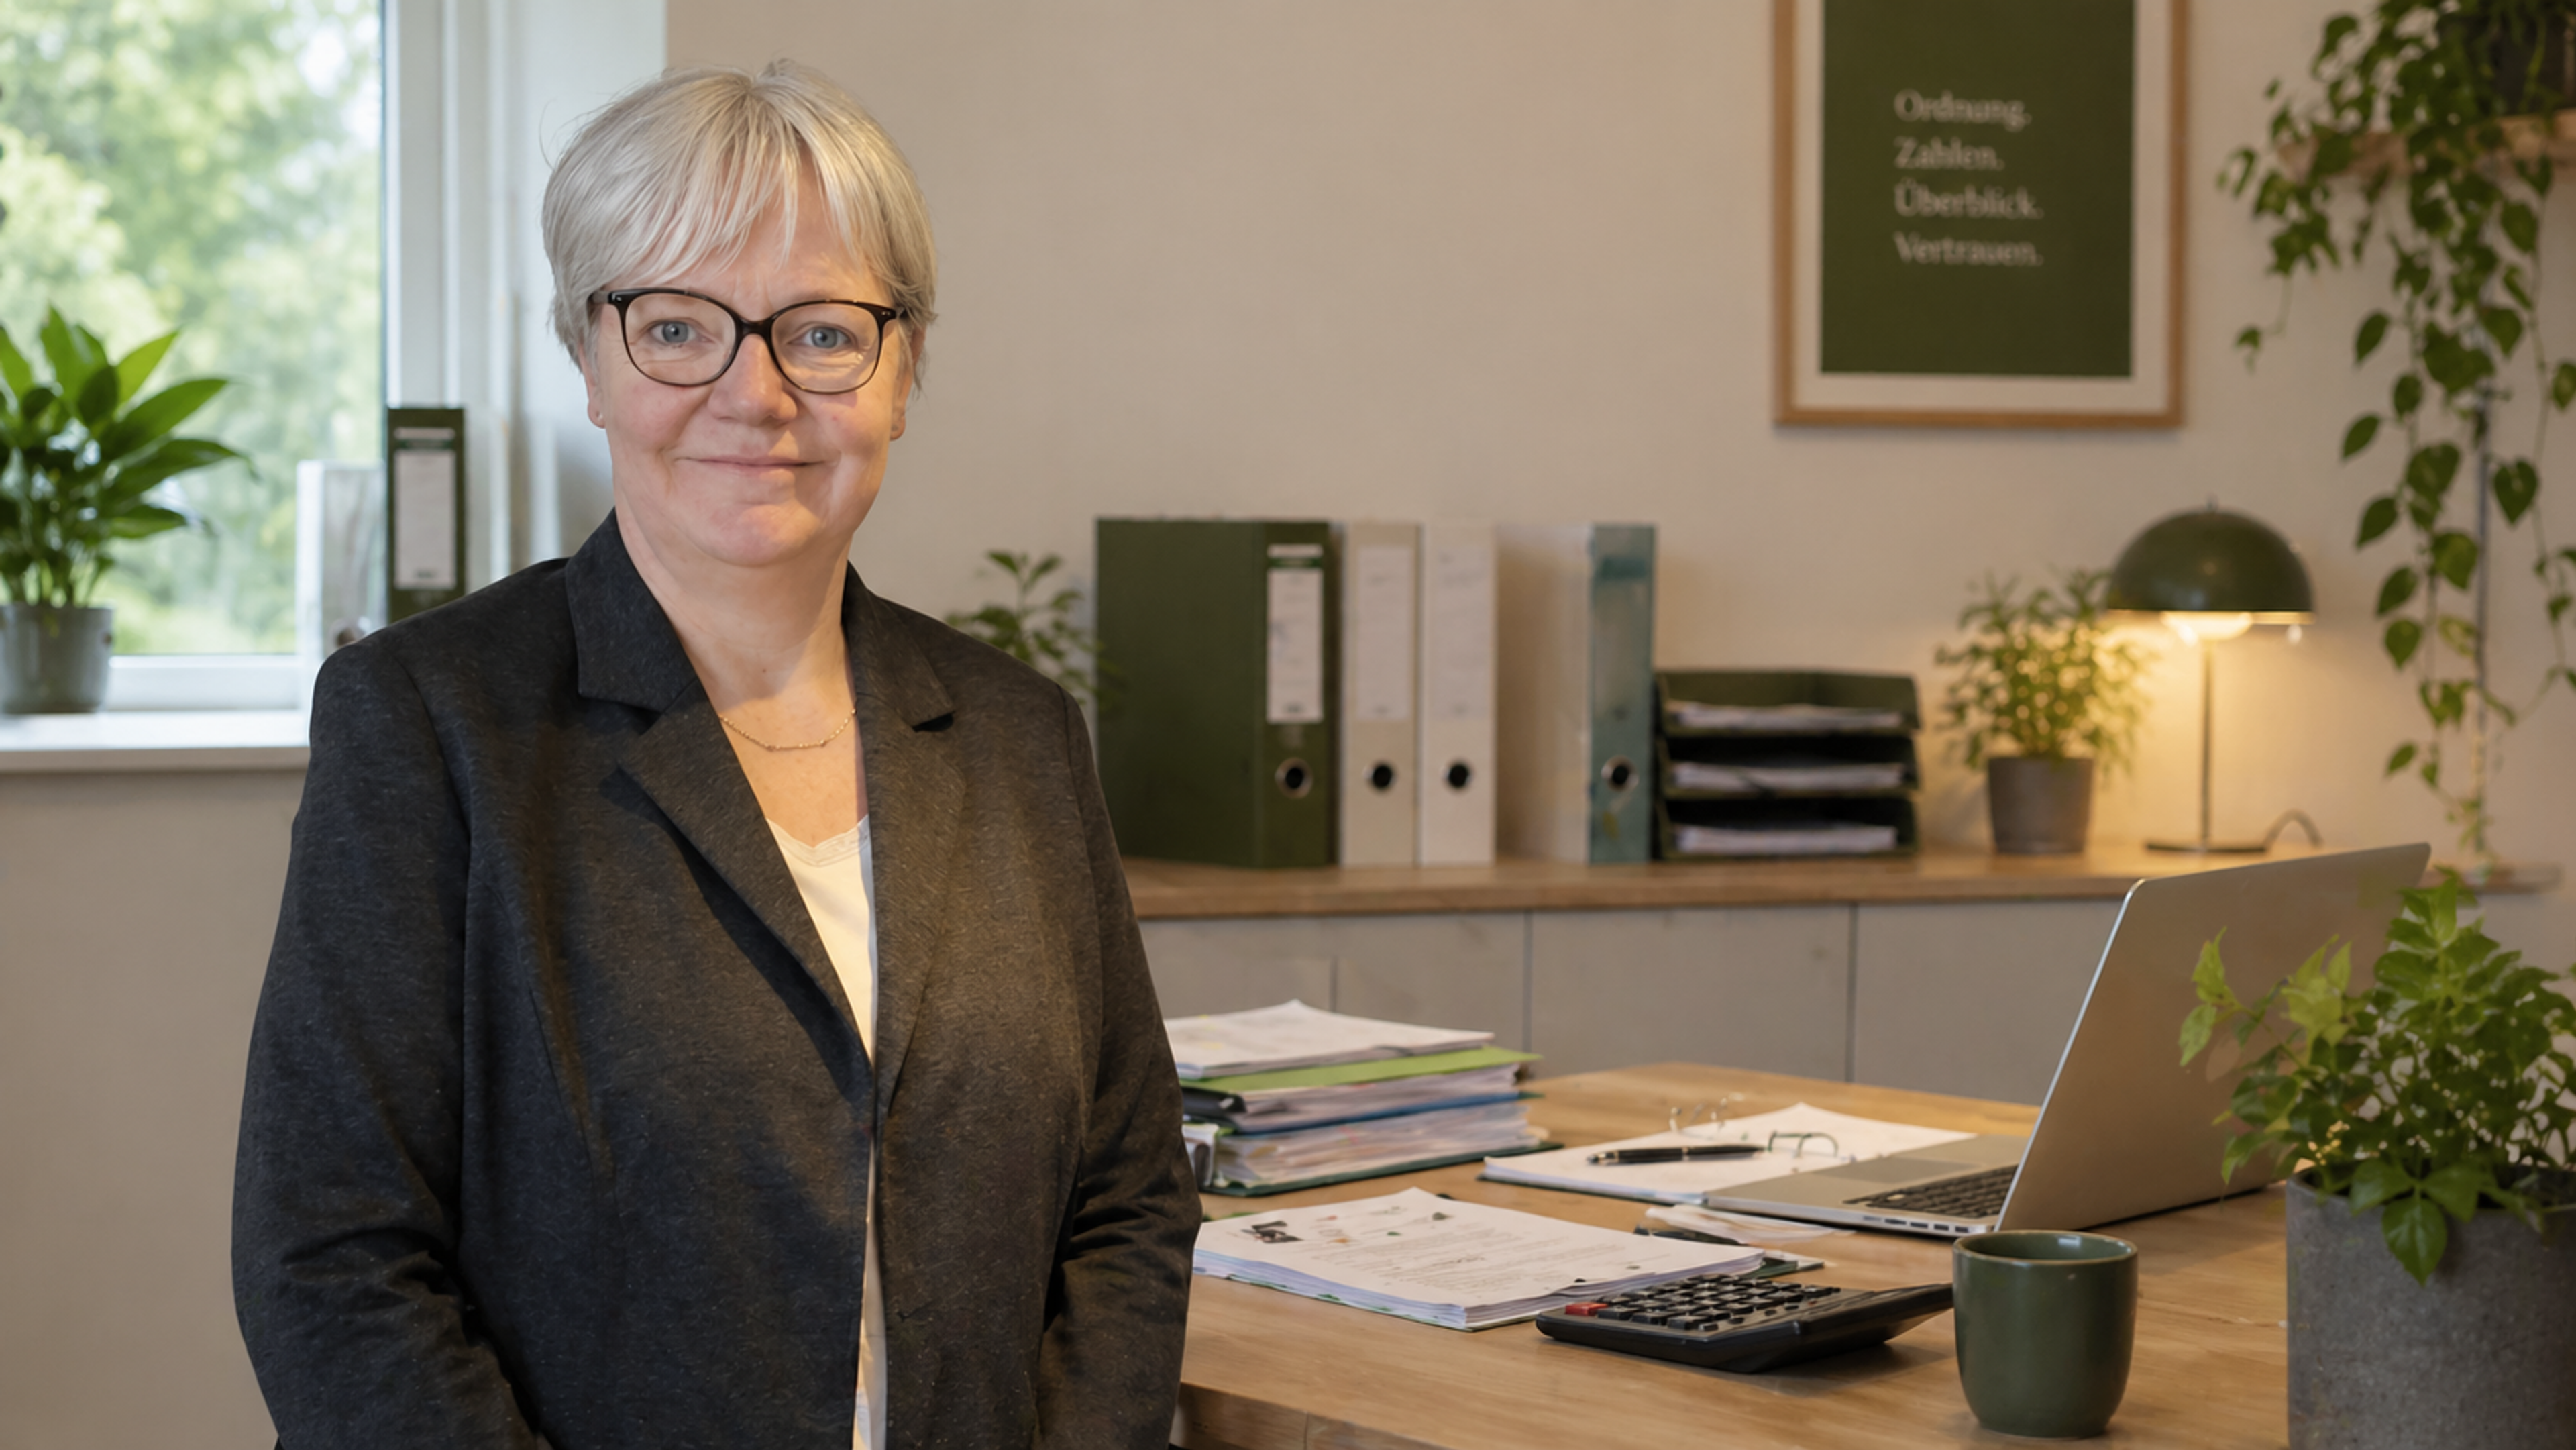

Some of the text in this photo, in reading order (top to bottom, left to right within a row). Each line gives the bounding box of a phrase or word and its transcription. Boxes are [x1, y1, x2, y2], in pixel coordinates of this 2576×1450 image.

[1893, 89, 2031, 132] Ordnung.
[1894, 136, 2004, 170] Zahlen.
[1893, 176, 2043, 219] Überblick.
[1893, 231, 2043, 266] Vertrauen.
